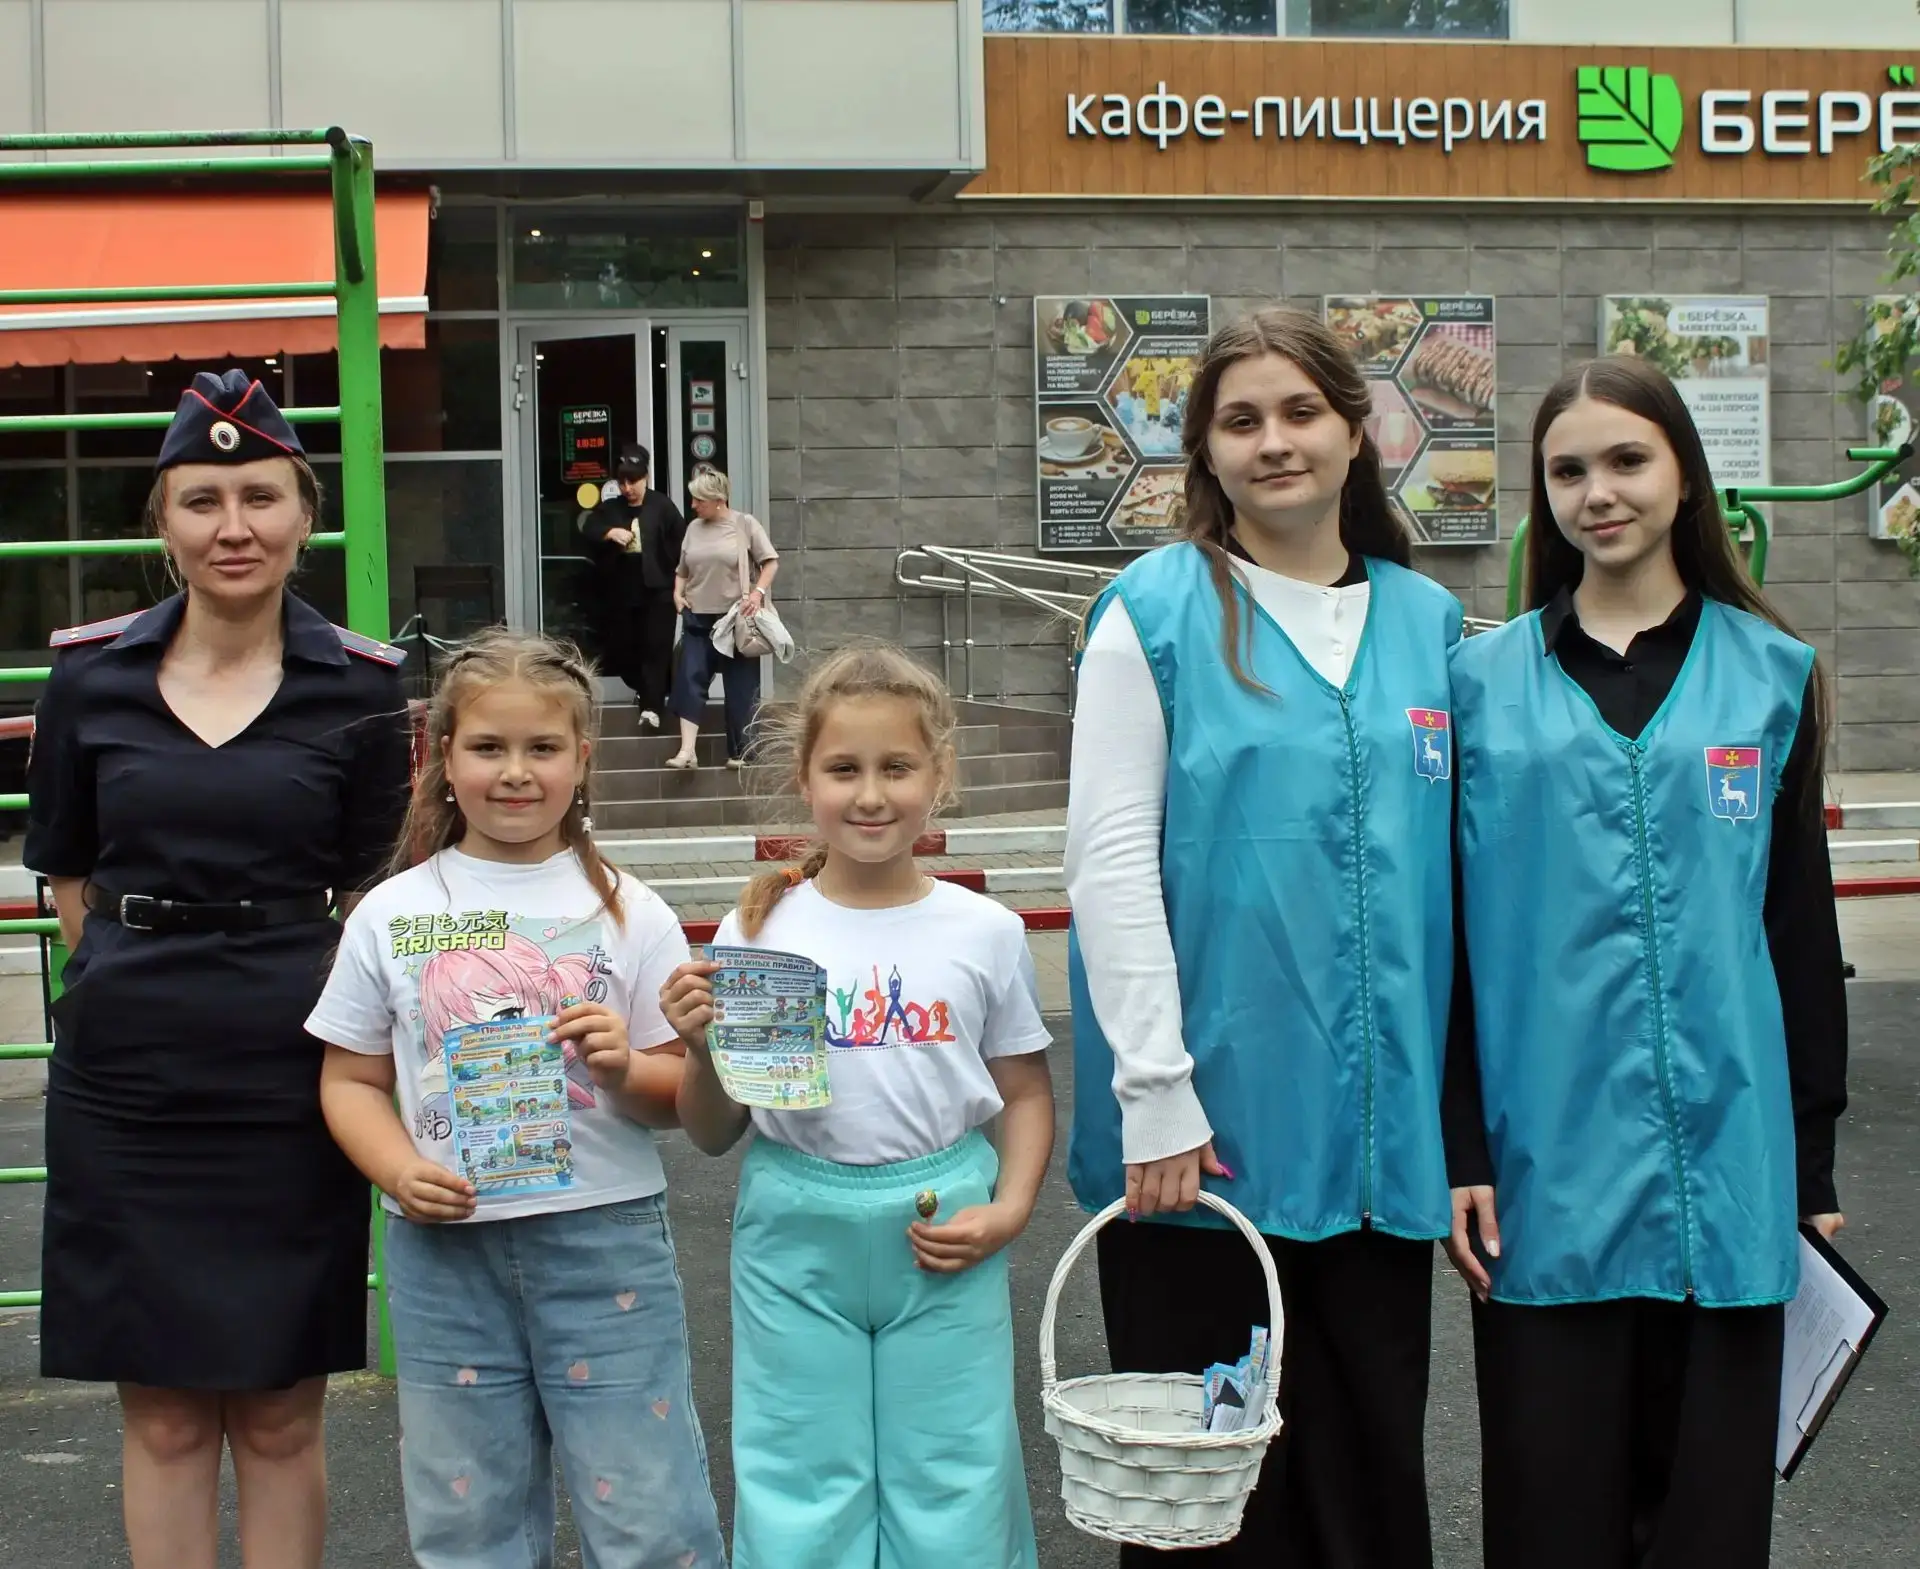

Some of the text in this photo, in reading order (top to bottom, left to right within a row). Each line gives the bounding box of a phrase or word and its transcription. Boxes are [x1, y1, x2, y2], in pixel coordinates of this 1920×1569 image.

[1067, 80, 1548, 151] кафе-пиццерия
[388, 909, 510, 938] 今日も元気
[391, 931, 506, 959] ARIGATO
